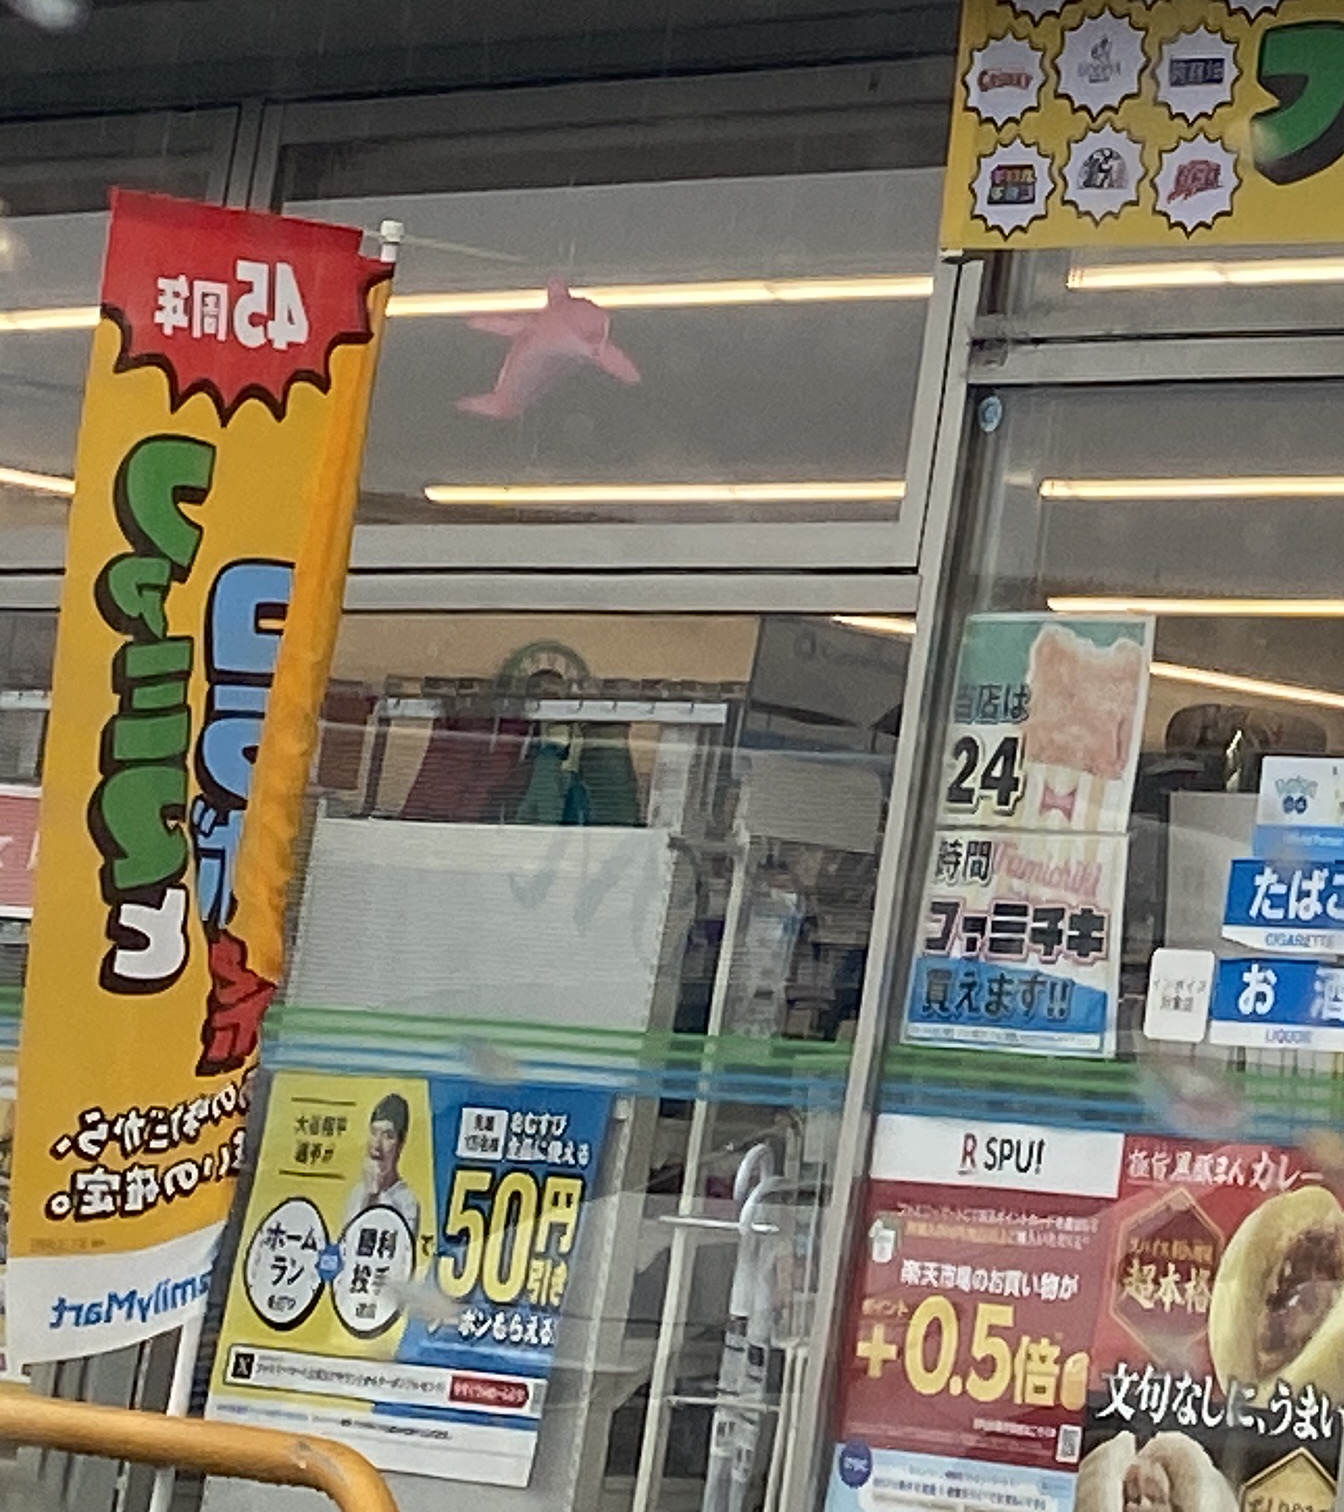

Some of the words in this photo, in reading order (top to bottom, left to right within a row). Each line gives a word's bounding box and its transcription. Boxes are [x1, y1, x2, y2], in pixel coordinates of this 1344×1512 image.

[954, 685, 1031, 725] 当店は
[946, 735, 1023, 810] 24
[934, 839, 994, 885] 時間
[922, 897, 1109, 961] ファミチキ
[983, 1137, 1045, 1175] SPU!
[1249, 1150, 1325, 1192] カレー
[262, 1220, 318, 1252] ホーム
[270, 1256, 305, 1286] ラン
[901, 1259, 1080, 1300] 楽天市場のお買い物が
